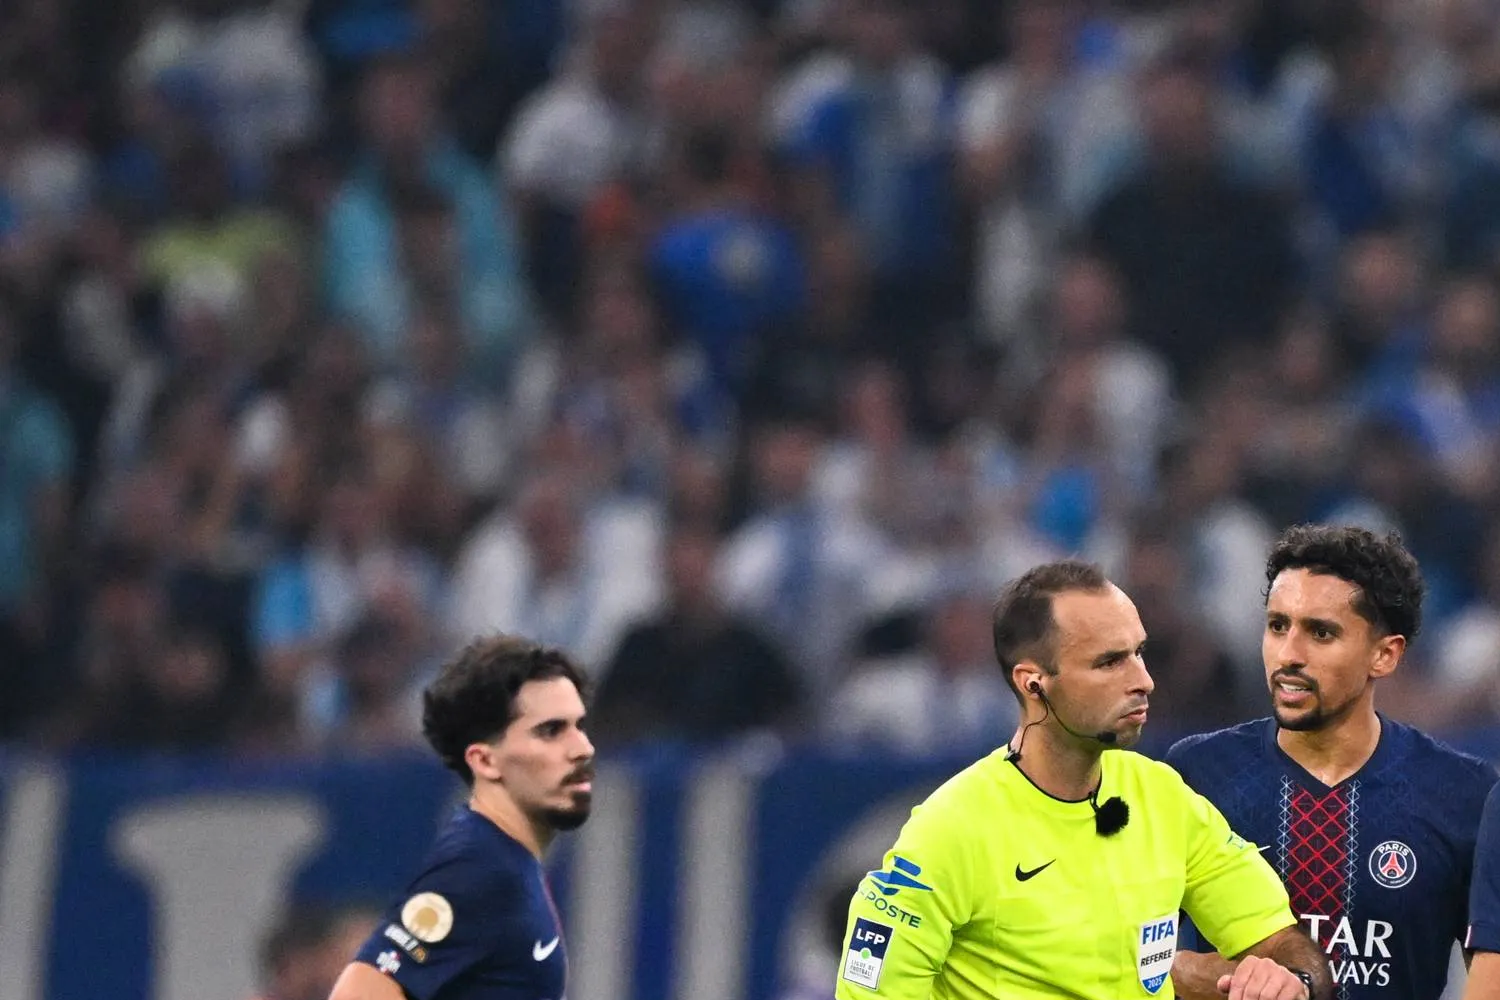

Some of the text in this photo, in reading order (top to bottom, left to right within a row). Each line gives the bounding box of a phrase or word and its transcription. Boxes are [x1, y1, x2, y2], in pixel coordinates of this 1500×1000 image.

[1378, 843, 1410, 856] PARIS
[855, 928, 886, 945] LFP
[1142, 920, 1175, 945] FIFA
[1300, 913, 1394, 958] TAR
[1140, 948, 1173, 967] REFEREE
[1147, 976, 1164, 989] 2025
